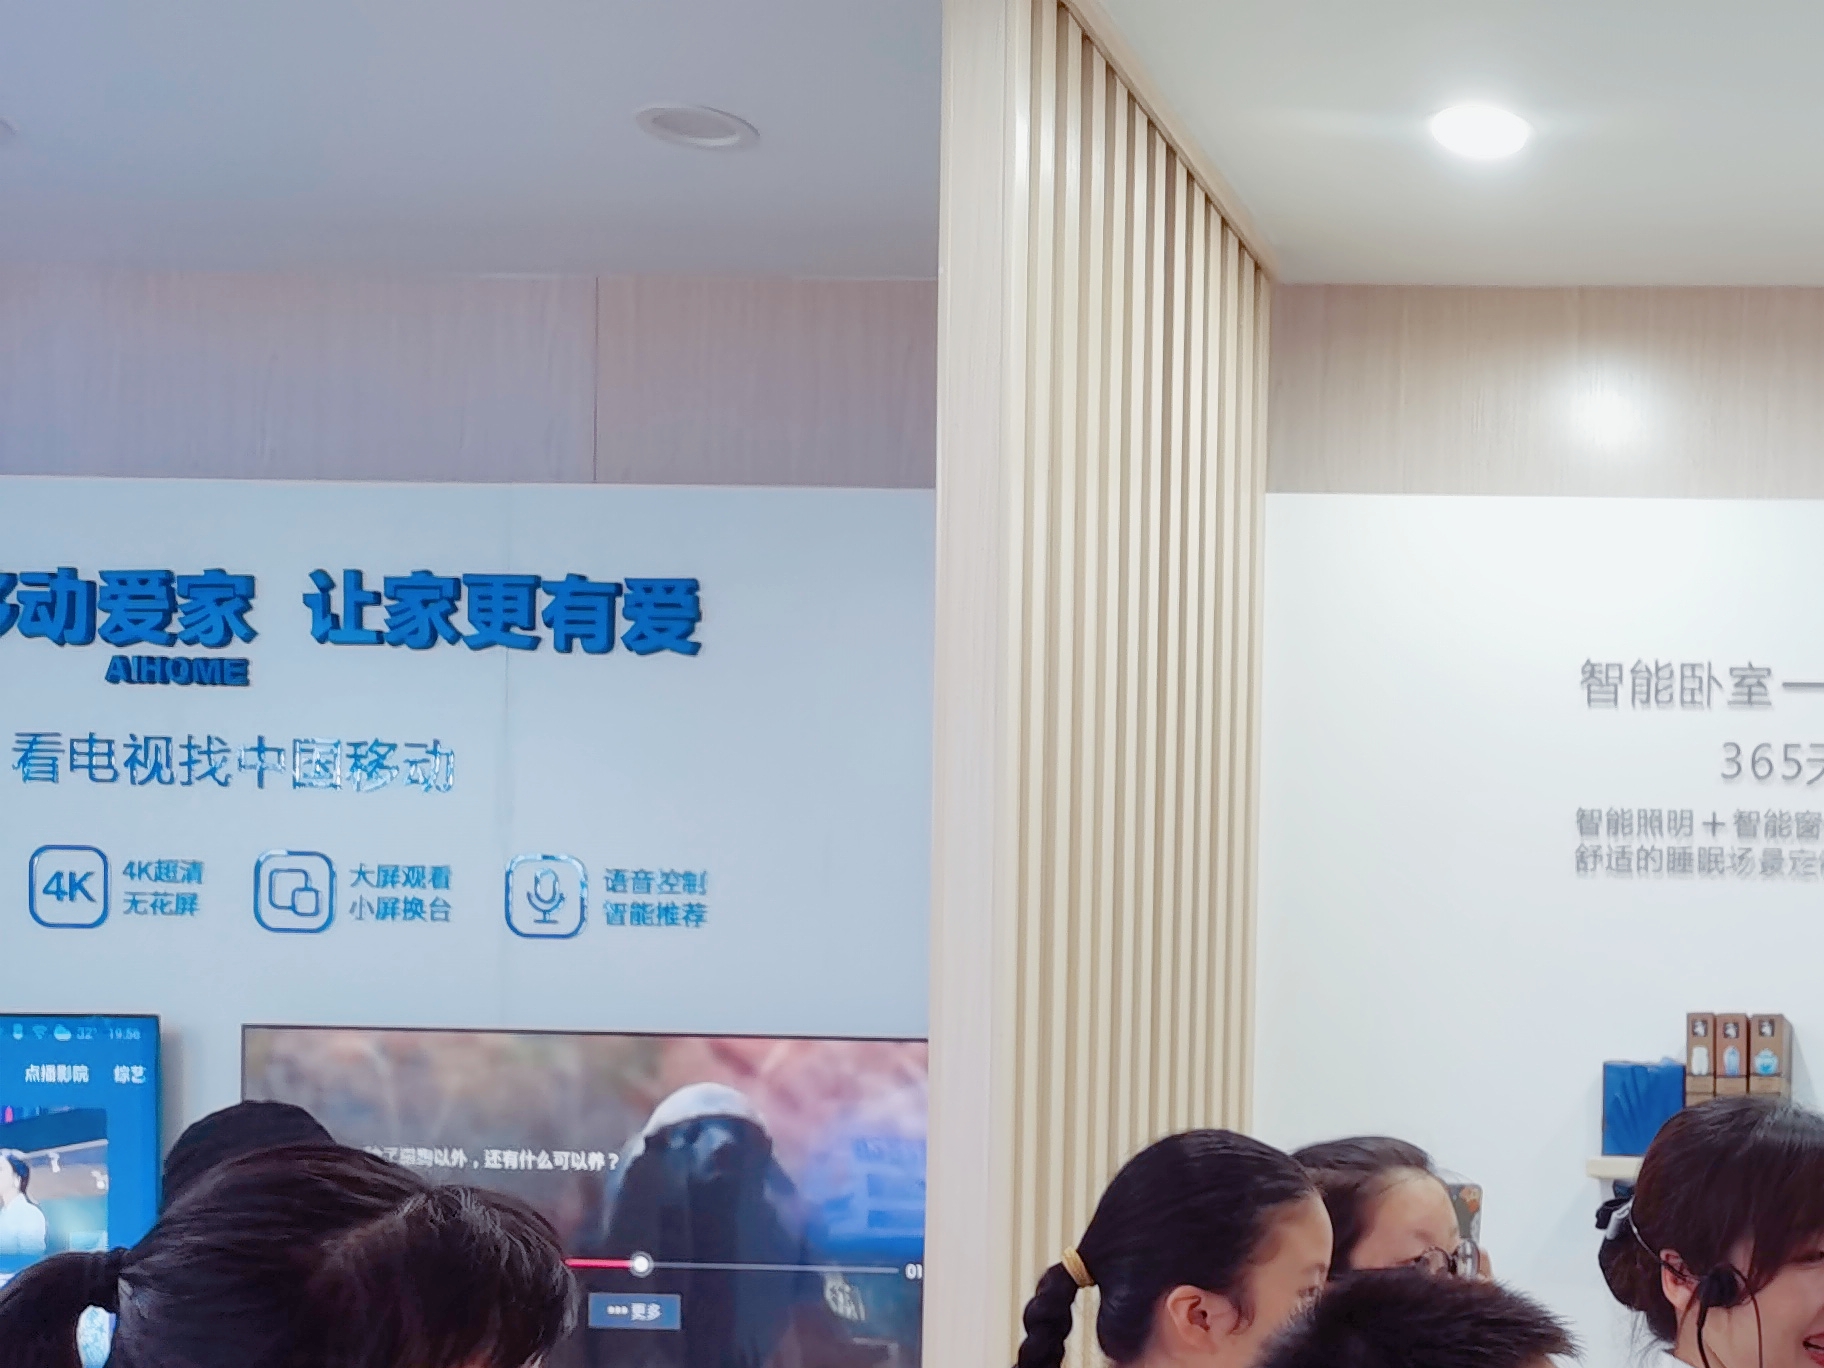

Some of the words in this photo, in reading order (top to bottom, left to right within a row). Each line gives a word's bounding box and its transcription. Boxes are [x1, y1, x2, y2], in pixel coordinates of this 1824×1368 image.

[0, 567, 258, 648] 动爱家
[301, 568, 703, 656] 让家更有爱
[104, 656, 251, 686] AIHOME
[11, 731, 457, 793] 看电视找中国移动
[122, 857, 205, 886] 4K超清
[349, 862, 453, 891] 大屏观看
[603, 867, 708, 896] 语音控制
[42, 870, 97, 904] 4K
[122, 889, 201, 918] 无花屏
[349, 895, 453, 923] 小屏换台
[603, 900, 708, 928] 智能推荐
[629, 1301, 662, 1322] 更多
